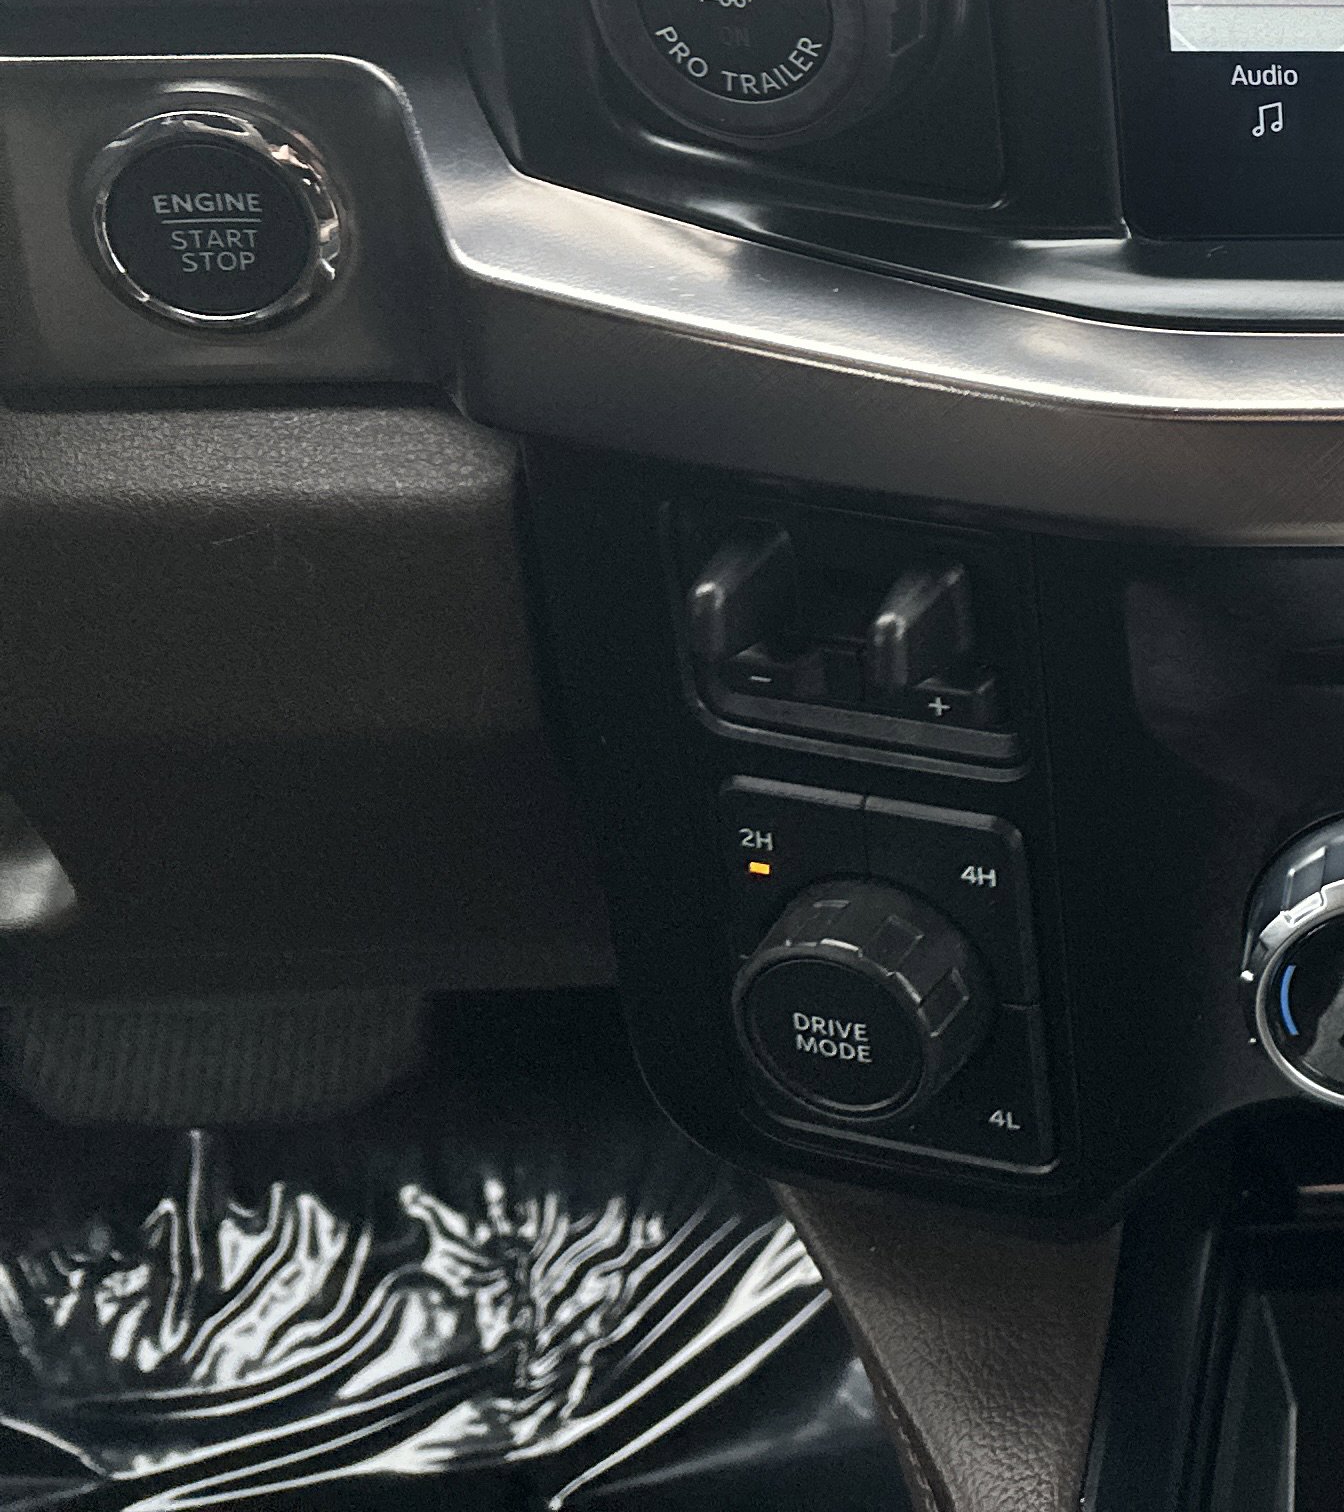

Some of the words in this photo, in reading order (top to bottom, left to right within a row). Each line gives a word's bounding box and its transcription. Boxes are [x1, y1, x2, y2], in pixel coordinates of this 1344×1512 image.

[655, 26, 709, 78] PRO
[721, 37, 823, 95] TRAILER
[1230, 63, 1298, 86] Audio
[152, 192, 263, 214] ENGINE
[171, 229, 258, 250] START
[181, 250, 256, 273] STOP
[739, 828, 773, 851] 2H
[960, 865, 997, 887] 4H
[793, 1012, 869, 1042] DRIVE
[796, 1033, 872, 1063] MODE
[988, 1109, 1021, 1130] 4L
